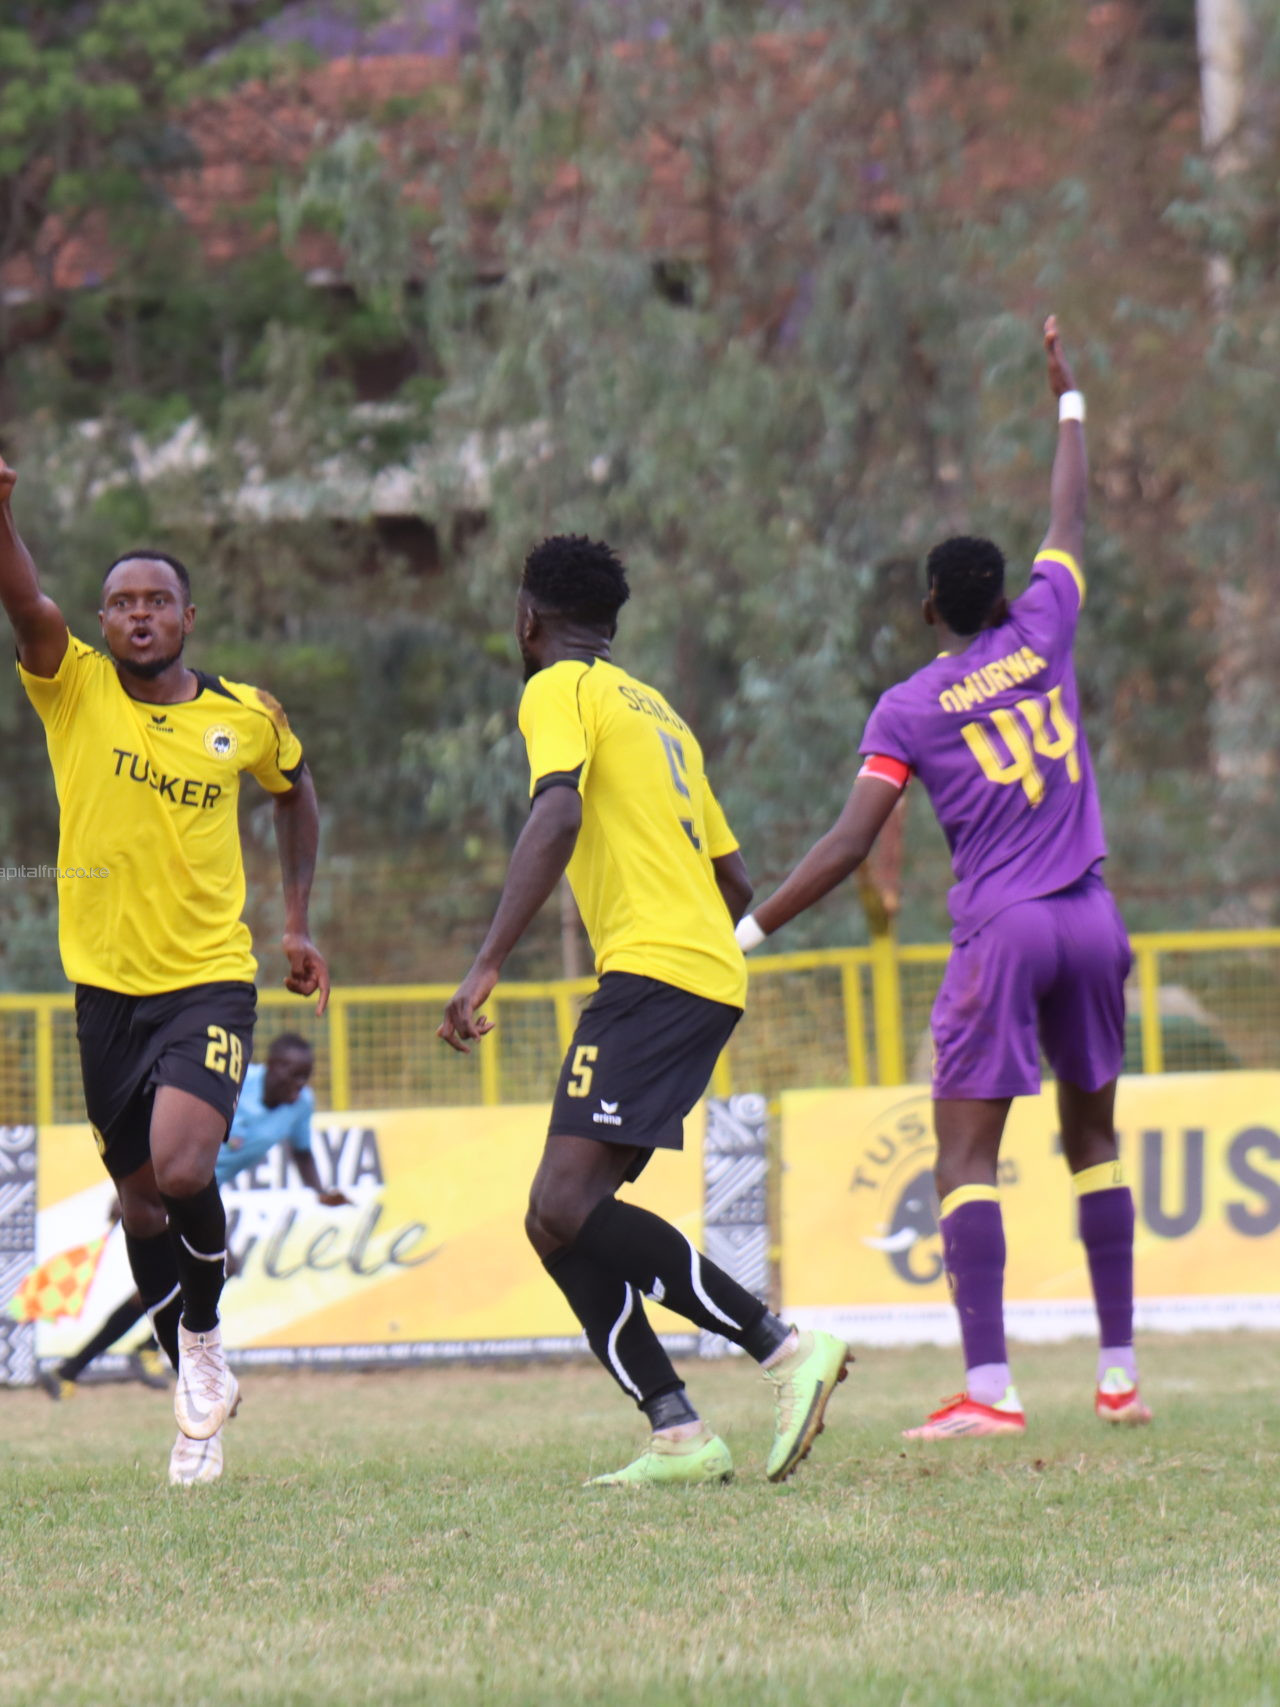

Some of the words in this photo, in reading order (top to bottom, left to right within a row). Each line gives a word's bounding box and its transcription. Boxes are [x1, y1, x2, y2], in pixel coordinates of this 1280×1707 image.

[938, 645, 1048, 712] OMURWA
[960, 685, 1081, 809] 44
[204, 1024, 243, 1085] 28
[567, 1045, 599, 1098] 5
[592, 1112, 623, 1127] erima
[221, 1127, 385, 1191] ENYA
[849, 1113, 1020, 1194] TUSR
[1053, 1125, 1280, 1238] US
[224, 1202, 446, 1281] ilele
